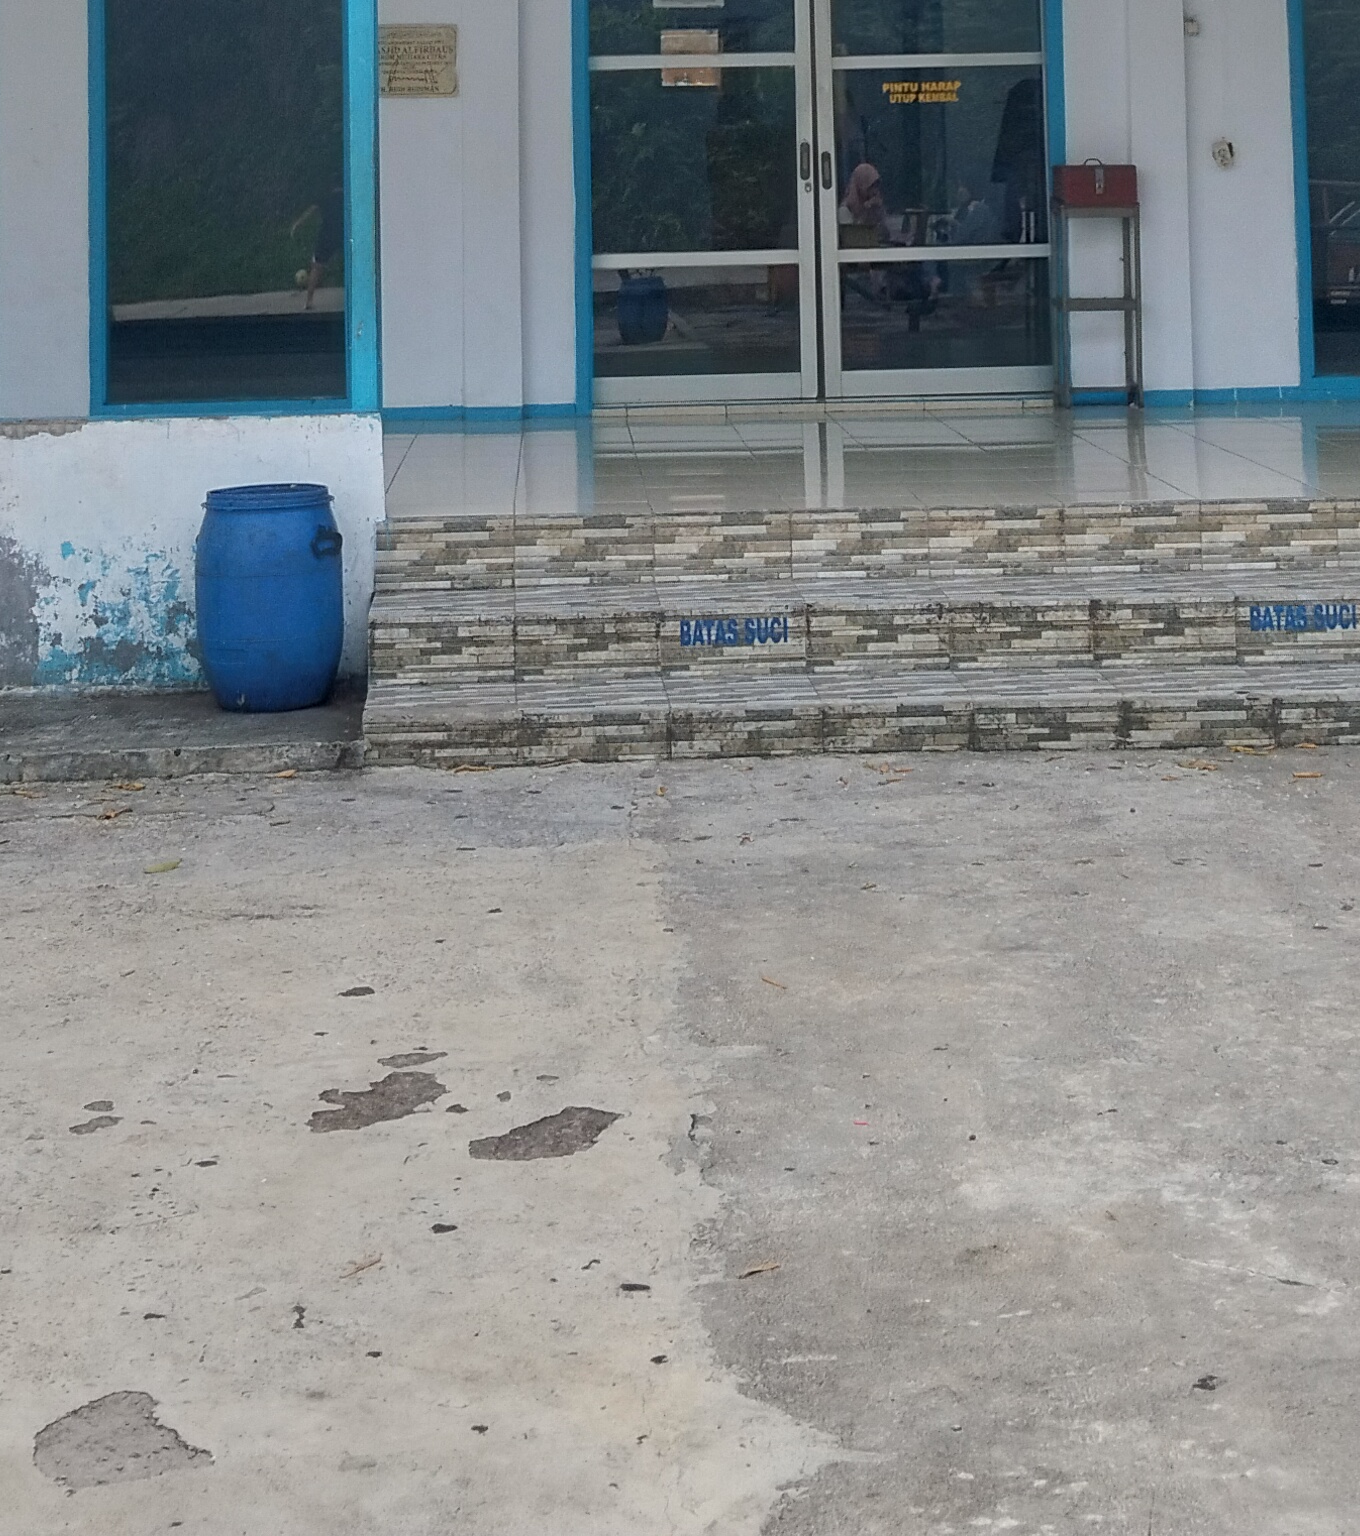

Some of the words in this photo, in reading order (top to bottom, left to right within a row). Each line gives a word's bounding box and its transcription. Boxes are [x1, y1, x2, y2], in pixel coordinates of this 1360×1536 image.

[882, 81, 918, 93] PINTU
[920, 80, 961, 92] HARAP
[680, 618, 738, 647] BATAS
[745, 616, 788, 645] SUCI
[1249, 604, 1307, 633] BATAS
[1314, 603, 1357, 632] SUCI
